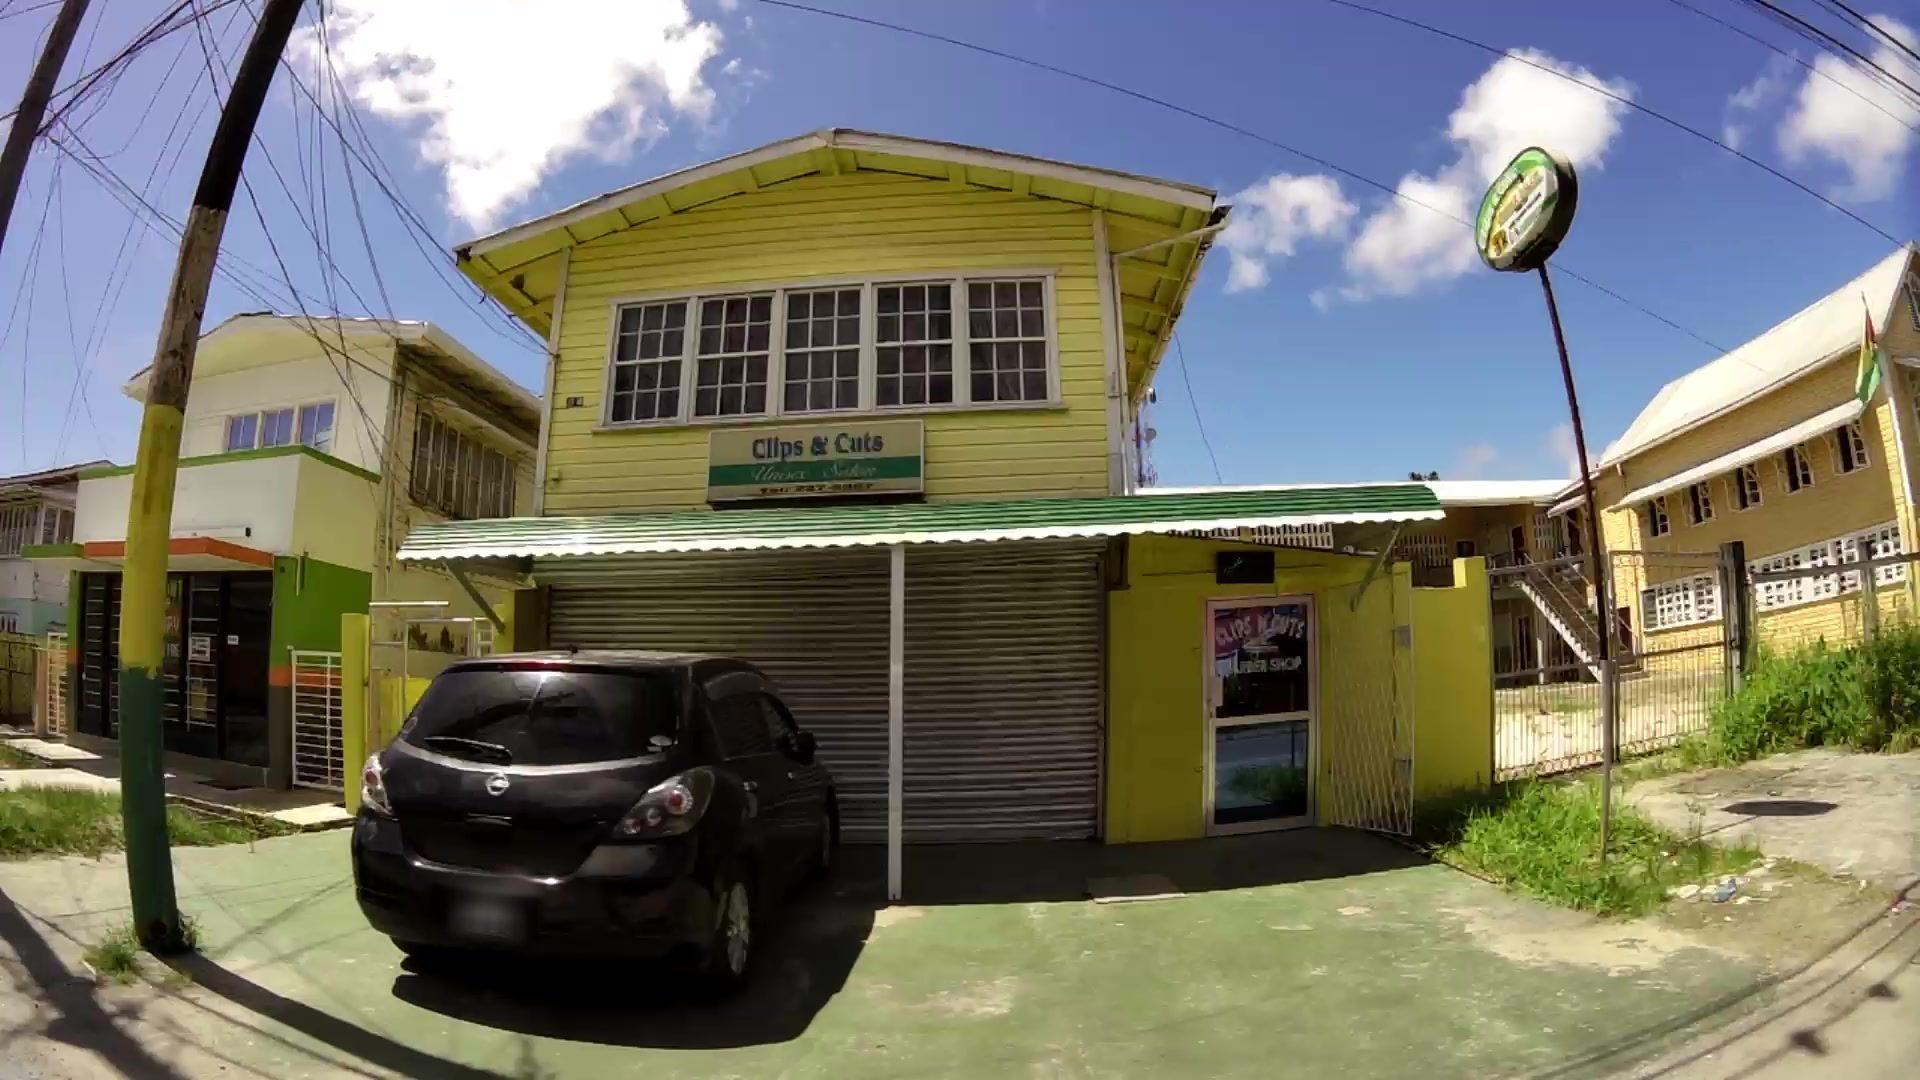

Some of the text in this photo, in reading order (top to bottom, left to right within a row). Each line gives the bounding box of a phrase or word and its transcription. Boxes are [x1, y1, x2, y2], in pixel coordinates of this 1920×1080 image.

[752, 431, 885, 460] Clips & Cuts
